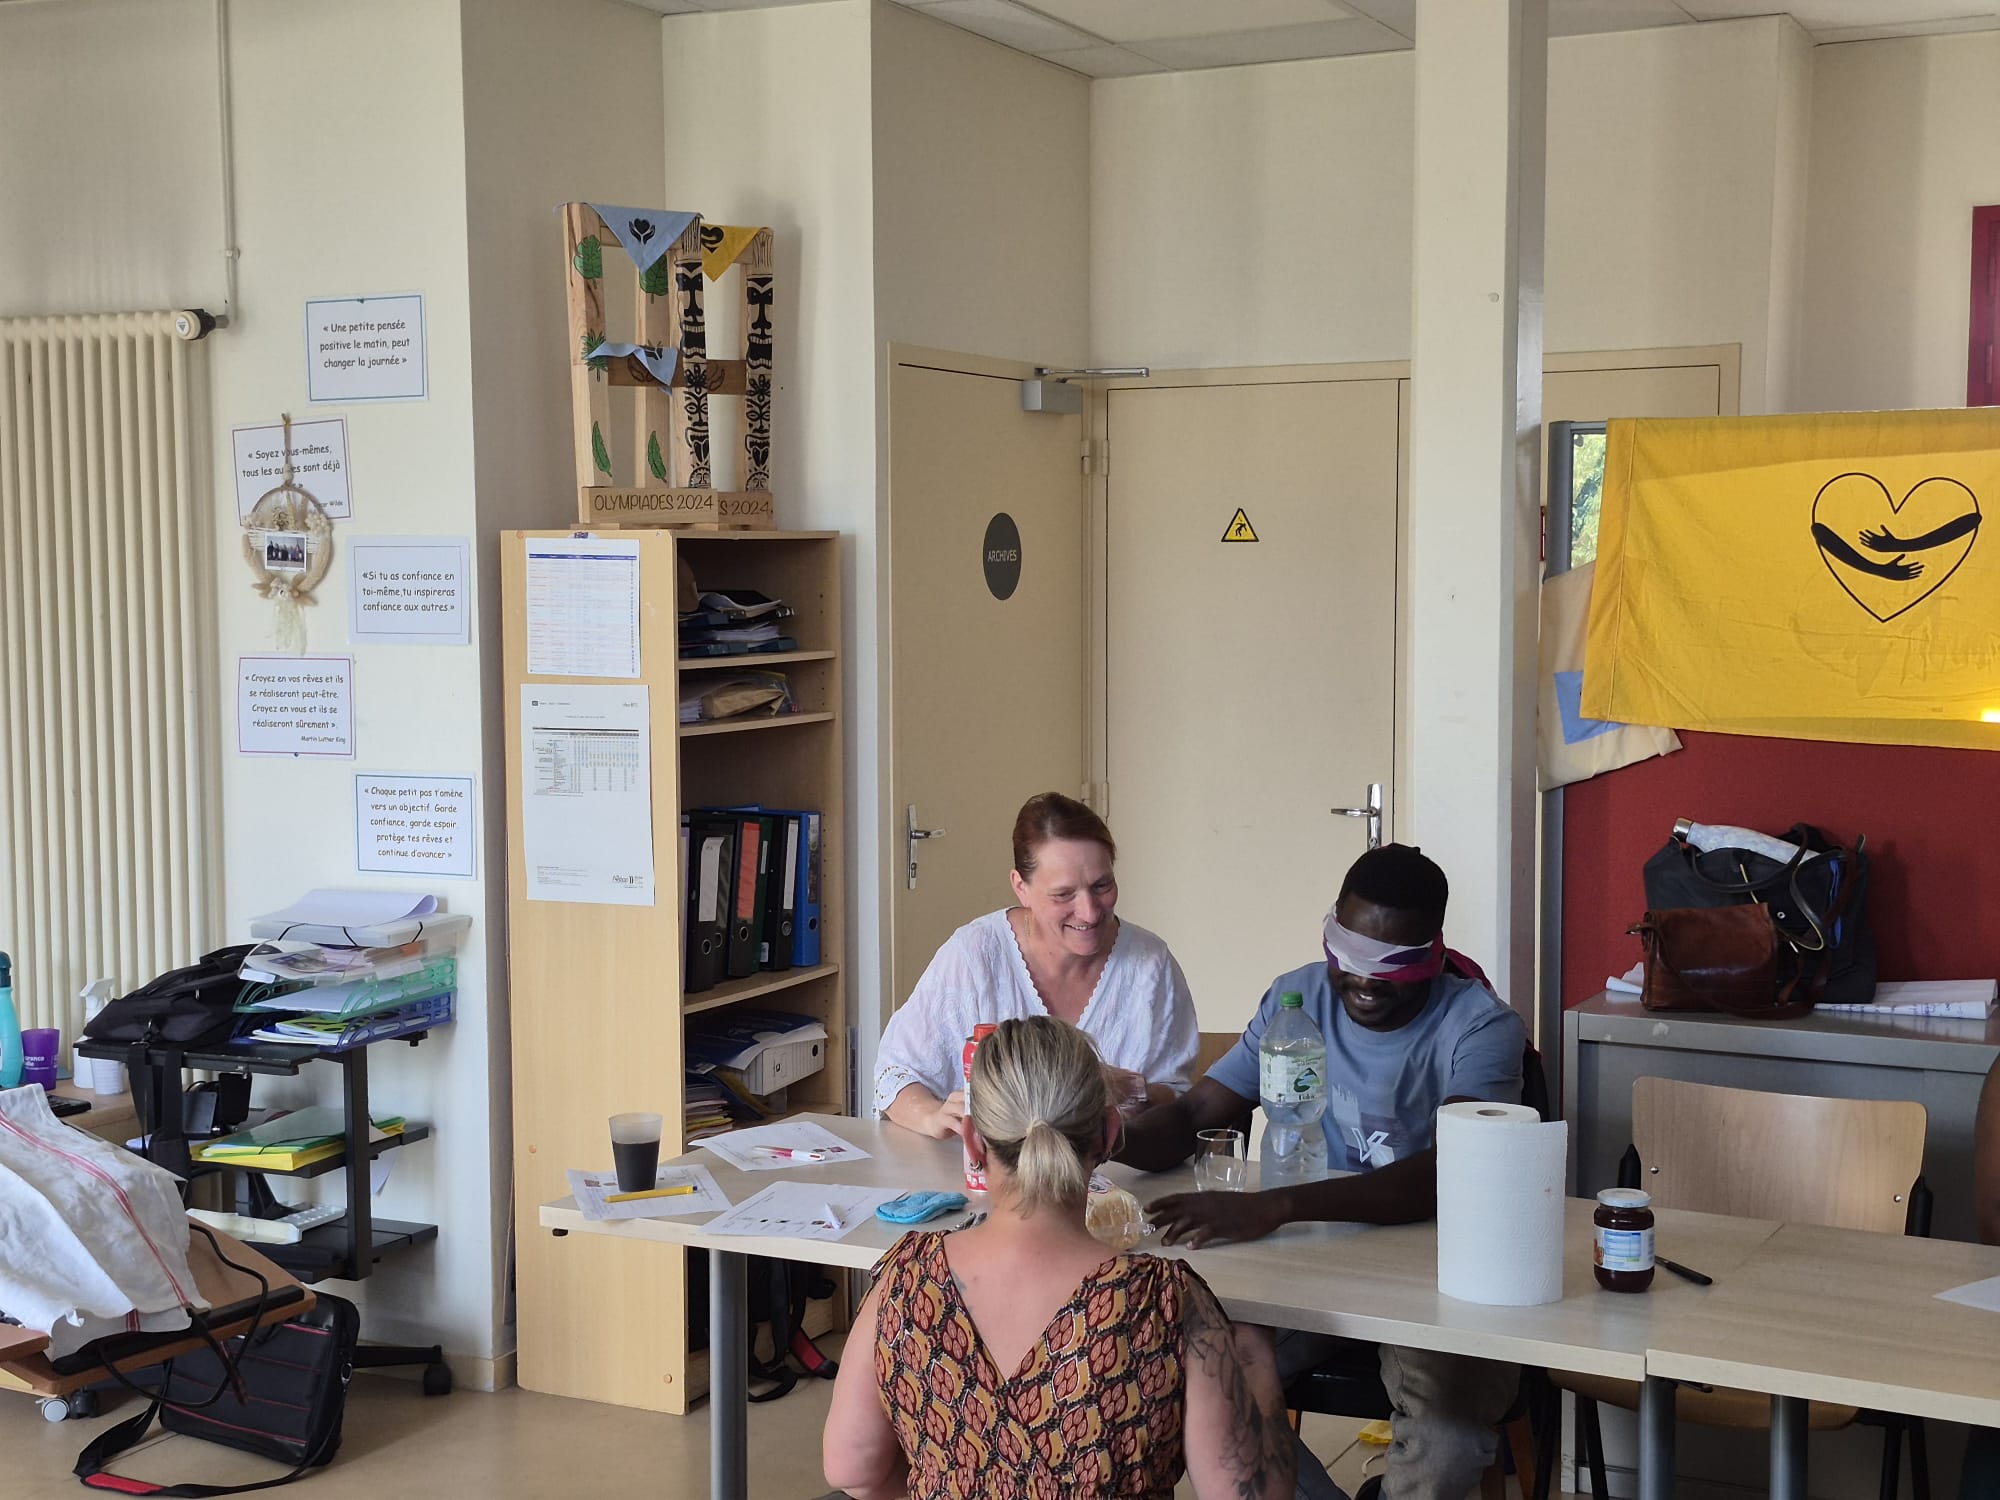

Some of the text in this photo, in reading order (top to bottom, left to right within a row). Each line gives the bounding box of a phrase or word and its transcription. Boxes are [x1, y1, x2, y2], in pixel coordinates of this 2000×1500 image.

[331, 323, 346, 332] Une
[349, 321, 375, 334] petite
[378, 320, 406, 333] pensée
[320, 340, 351, 352] positive
[354, 339, 361, 349] le
[392, 338, 410, 349] peut
[324, 358, 355, 370] changer
[358, 357, 365, 366] la
[368, 355, 399, 368] journée
[256, 451, 279, 460] Soyez
[262, 467, 272, 476] les
[304, 463, 320, 472] sont
[323, 460, 340, 472] déjà
[594, 494, 714, 511] OLYMPIADES 2024
[988, 550, 1018, 562] ARCHIVES
[380, 572, 388, 580] tu
[402, 571, 442, 580] confiance
[414, 587, 455, 598] inspireras
[363, 601, 401, 611] confiance
[252, 674, 275, 682] Croyez
[303, 674, 322, 683] rêves
[260, 689, 300, 697] réaliseront
[252, 704, 277, 714] Croyez
[296, 720, 329, 728] sûrement
[371, 786, 396, 797] Chaque
[399, 789, 417, 798] petit
[420, 790, 432, 798] pas
[435, 804, 457, 813] Garde
[371, 818, 407, 828] confiance,
[410, 820, 431, 829] garde
[377, 833, 405, 843] protège
[422, 834, 442, 843] rêves
[411, 850, 446, 858] d'avancer
